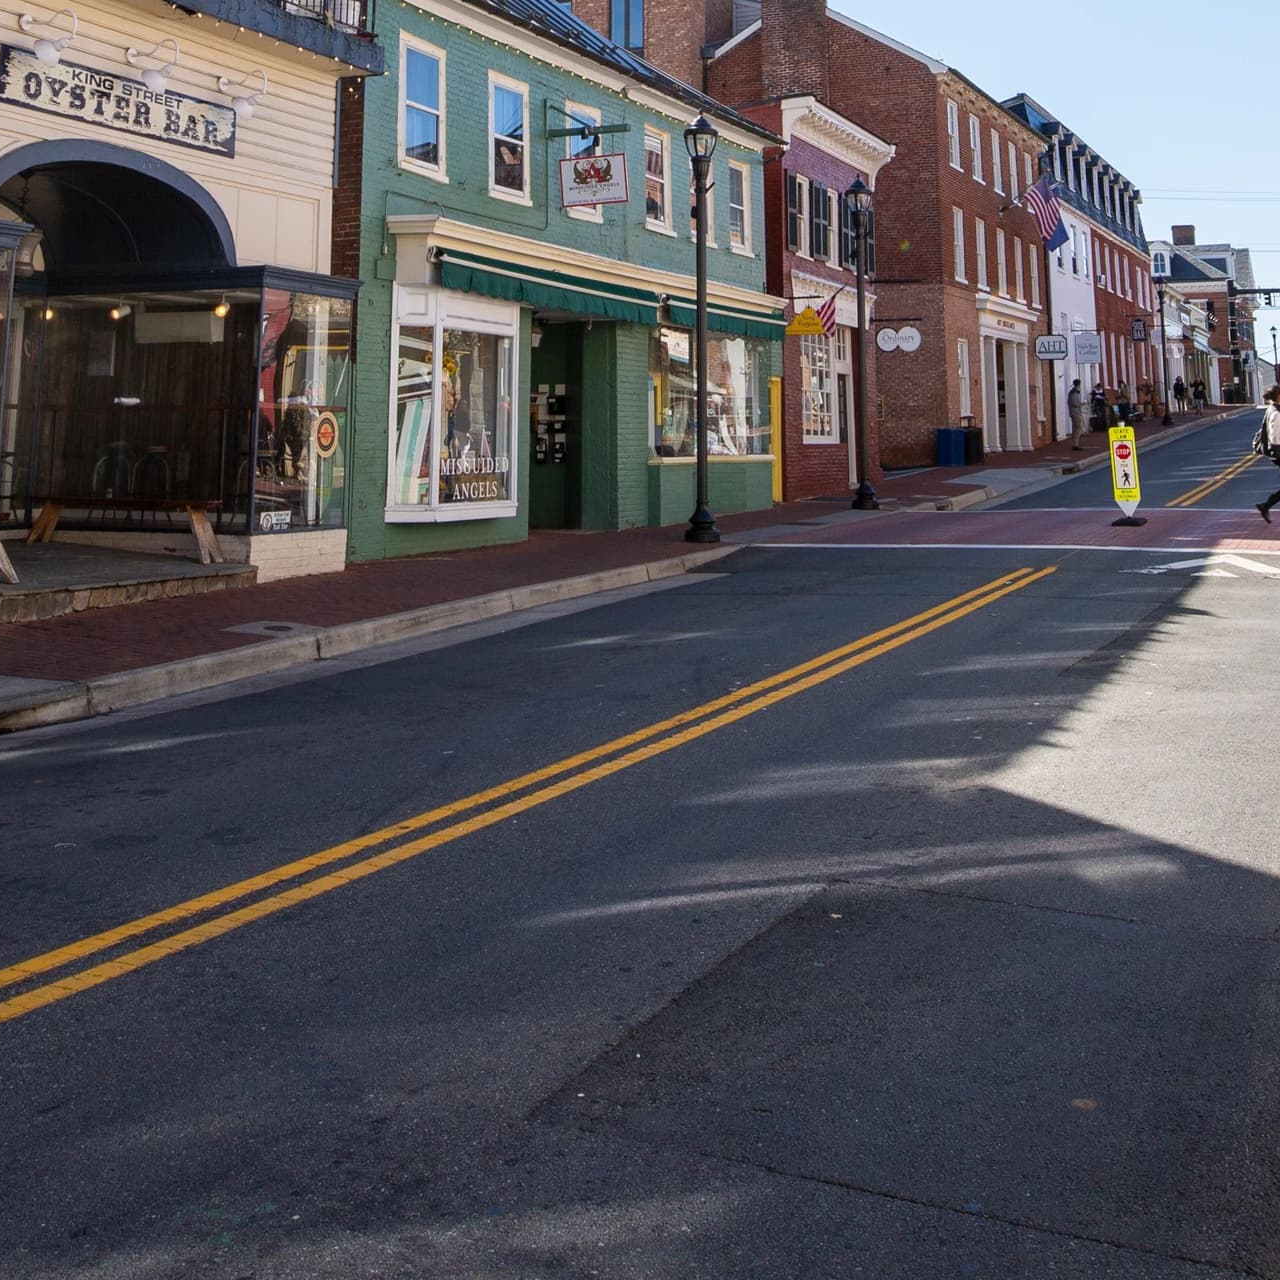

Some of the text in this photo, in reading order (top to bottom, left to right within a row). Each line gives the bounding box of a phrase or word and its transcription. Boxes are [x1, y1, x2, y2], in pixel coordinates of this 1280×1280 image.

[72, 69, 183, 109] KING STREET
[24, 72, 220, 145] OYSTER BAR
[882, 334, 915, 344] Ordinary
[1039, 340, 1065, 352] AHT
[1116, 448, 1130, 456] STOP
[440, 457, 509, 475] MISGUIDED
[452, 481, 498, 499] ANGELS
